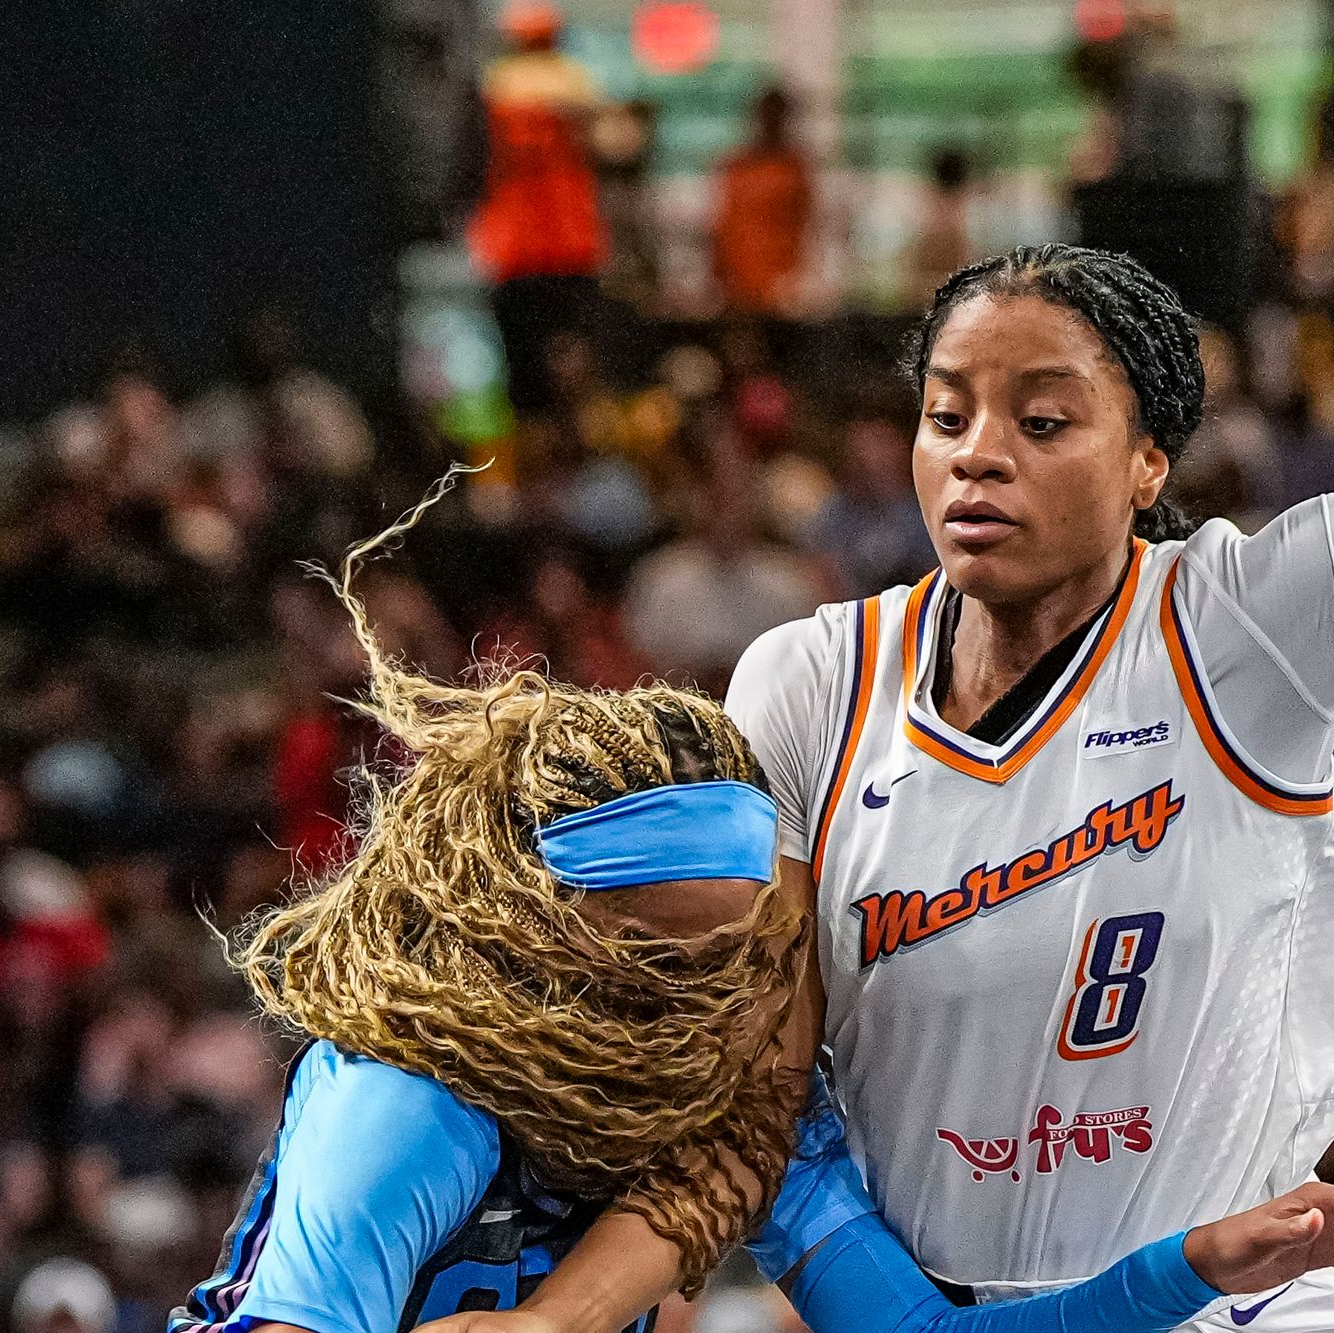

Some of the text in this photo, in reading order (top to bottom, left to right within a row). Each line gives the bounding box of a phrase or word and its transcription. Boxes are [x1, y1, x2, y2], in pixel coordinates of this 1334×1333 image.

[1084, 720, 1169, 748] Flipper's
[1133, 734, 1168, 747] WORLD
[851, 778, 1185, 970] Mercury
[1058, 912, 1165, 1061] 8
[1084, 1108, 1142, 1125] STORES
